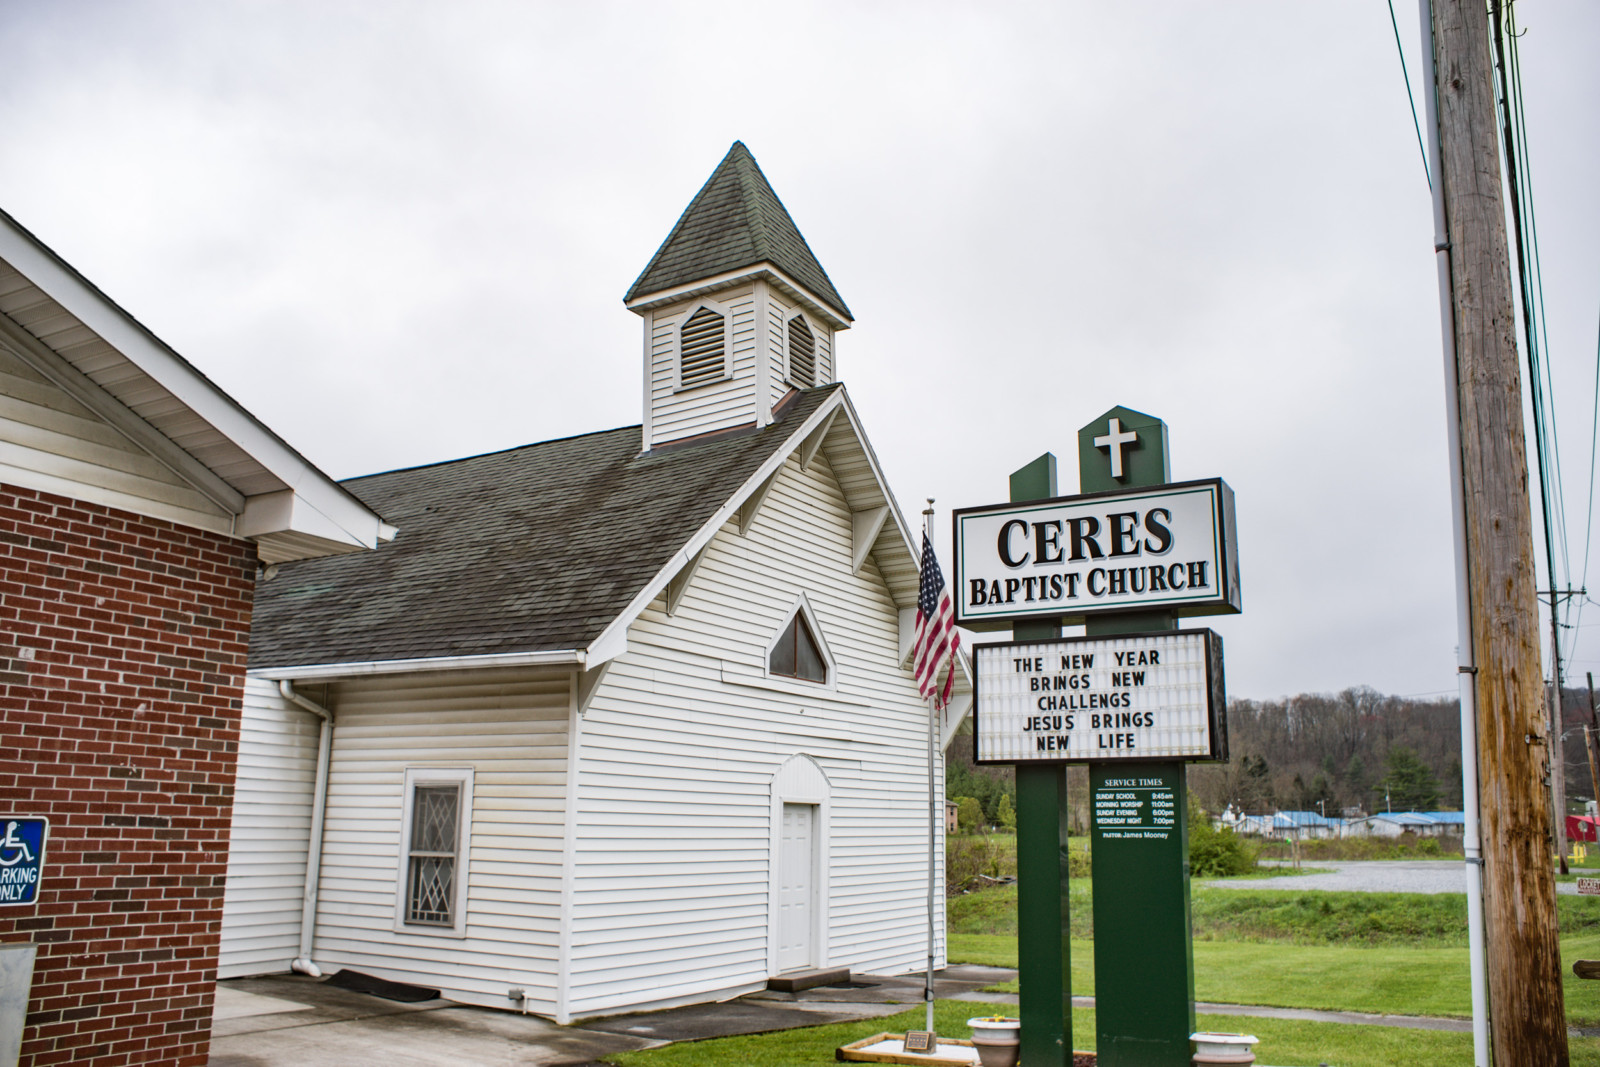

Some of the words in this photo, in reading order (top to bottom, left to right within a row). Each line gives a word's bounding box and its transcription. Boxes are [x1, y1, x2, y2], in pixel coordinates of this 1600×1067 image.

[997, 508, 1173, 568] CERES
[969, 573, 1080, 607] BAPTIST
[1087, 560, 1208, 596] CHURCH
[1013, 657, 1043, 673] THE
[1061, 654, 1094, 670] NEW
[1114, 650, 1160, 667] YEAR
[1030, 674, 1090, 691] BRINGS
[1112, 671, 1145, 687] NEW
[1037, 692, 1131, 711] CHALLENGS
[1023, 715, 1075, 732] JESUS
[1091, 712, 1154, 729] BRINGS
[1037, 735, 1069, 751] NEW
[1098, 733, 1136, 749] LIFE
[1104, 779, 1136, 787] SERVICE
[1138, 778, 1162, 786] TIMES
[1143, 832, 1169, 840] Mooney
[0, 867, 37, 884] RKING
[0, 884, 26, 900] NLY
